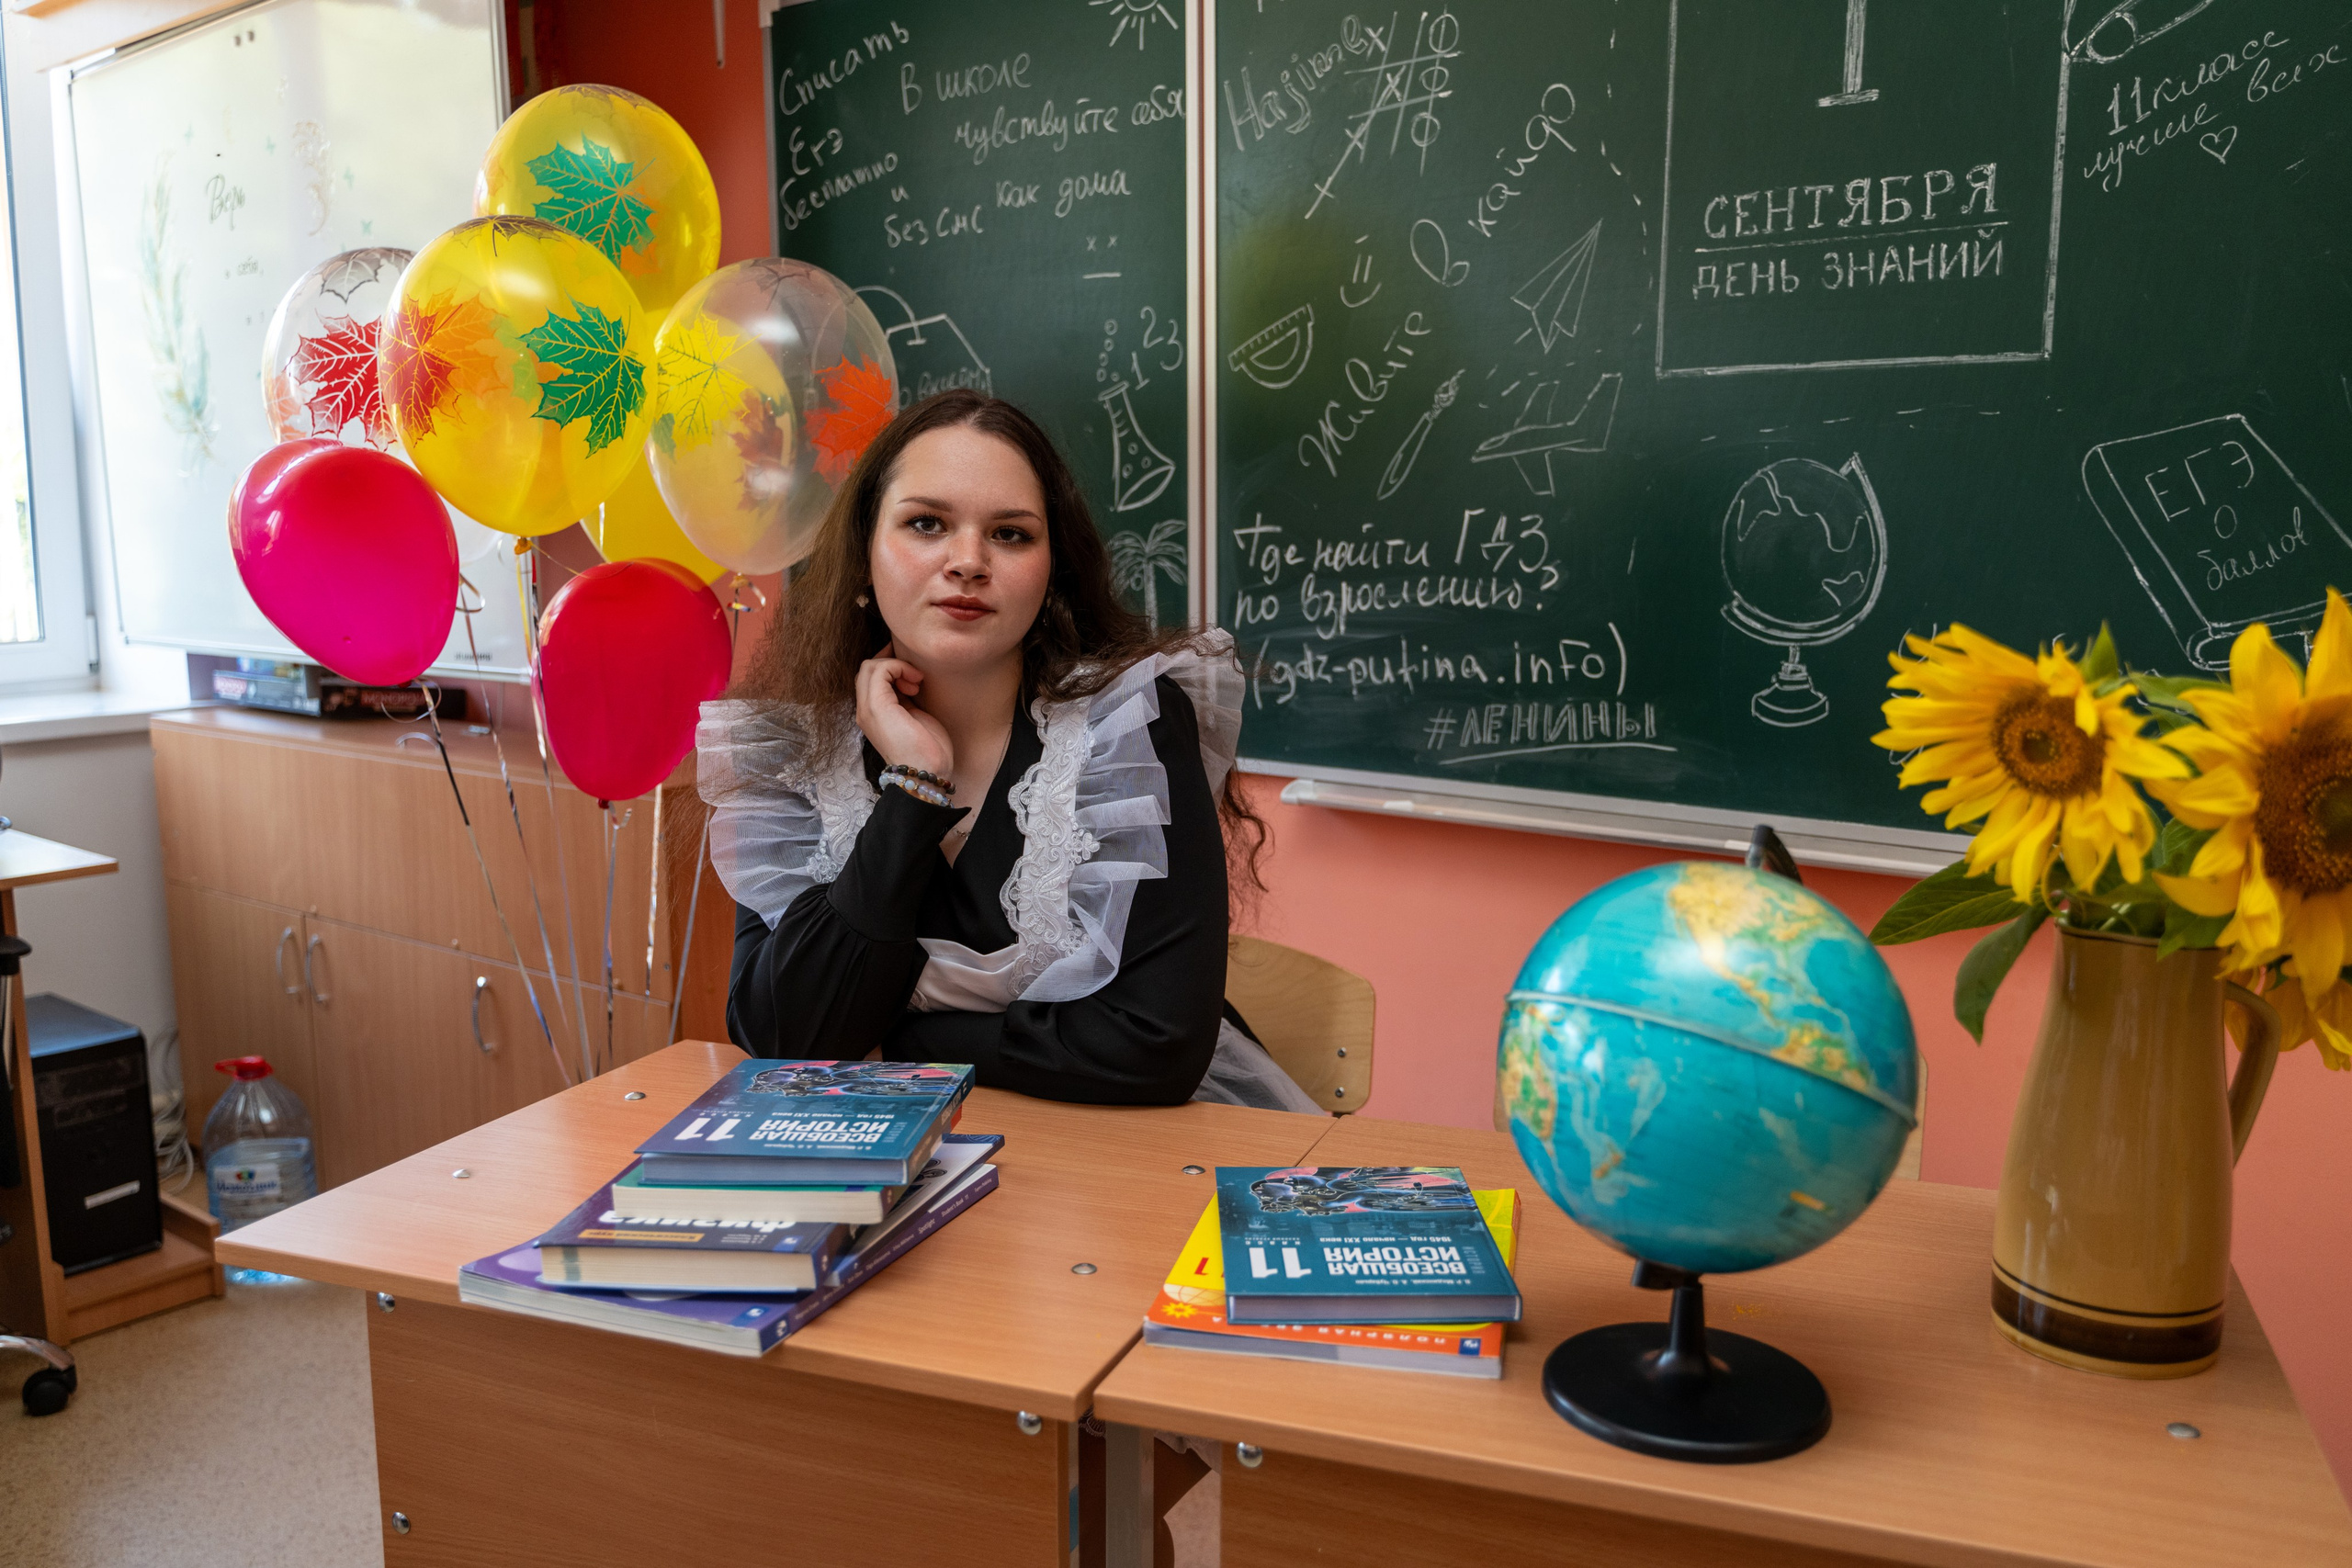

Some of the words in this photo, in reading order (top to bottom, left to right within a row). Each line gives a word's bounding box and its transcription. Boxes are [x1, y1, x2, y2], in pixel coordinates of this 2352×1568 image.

[935, 52, 1032, 102] школе
[955, 96, 1120, 166] чувствуйте
[779, 152, 899, 231] бесплатно
[1055, 168, 1133, 219] дома
[1703, 163, 1998, 239] СЕНТЯБРЯ
[884, 213, 929, 248] без
[1692, 258, 1801, 300] ДЕНЬ
[1821, 227, 2004, 290] ЗНАНИЙ
[2145, 441, 2255, 522] ЕГЭ
[1313, 523, 1430, 572] найти
[2197, 506, 2310, 591] баллов
[1235, 590, 1281, 630] по
[674, 1117, 741, 1142] 11
[749, 1131, 882, 1144] ВСЕОБЩАЯ
[758, 1119, 890, 1134] ИСТОРИЯ
[1250, 1247, 1312, 1279] 11
[1323, 1247, 1461, 1262] ИСТОРИЯ
[1327, 1261, 1467, 1275] ВСЕОБЩАЯ
[1318, 1325, 1446, 1344] ПОЛЯРНАЯ
